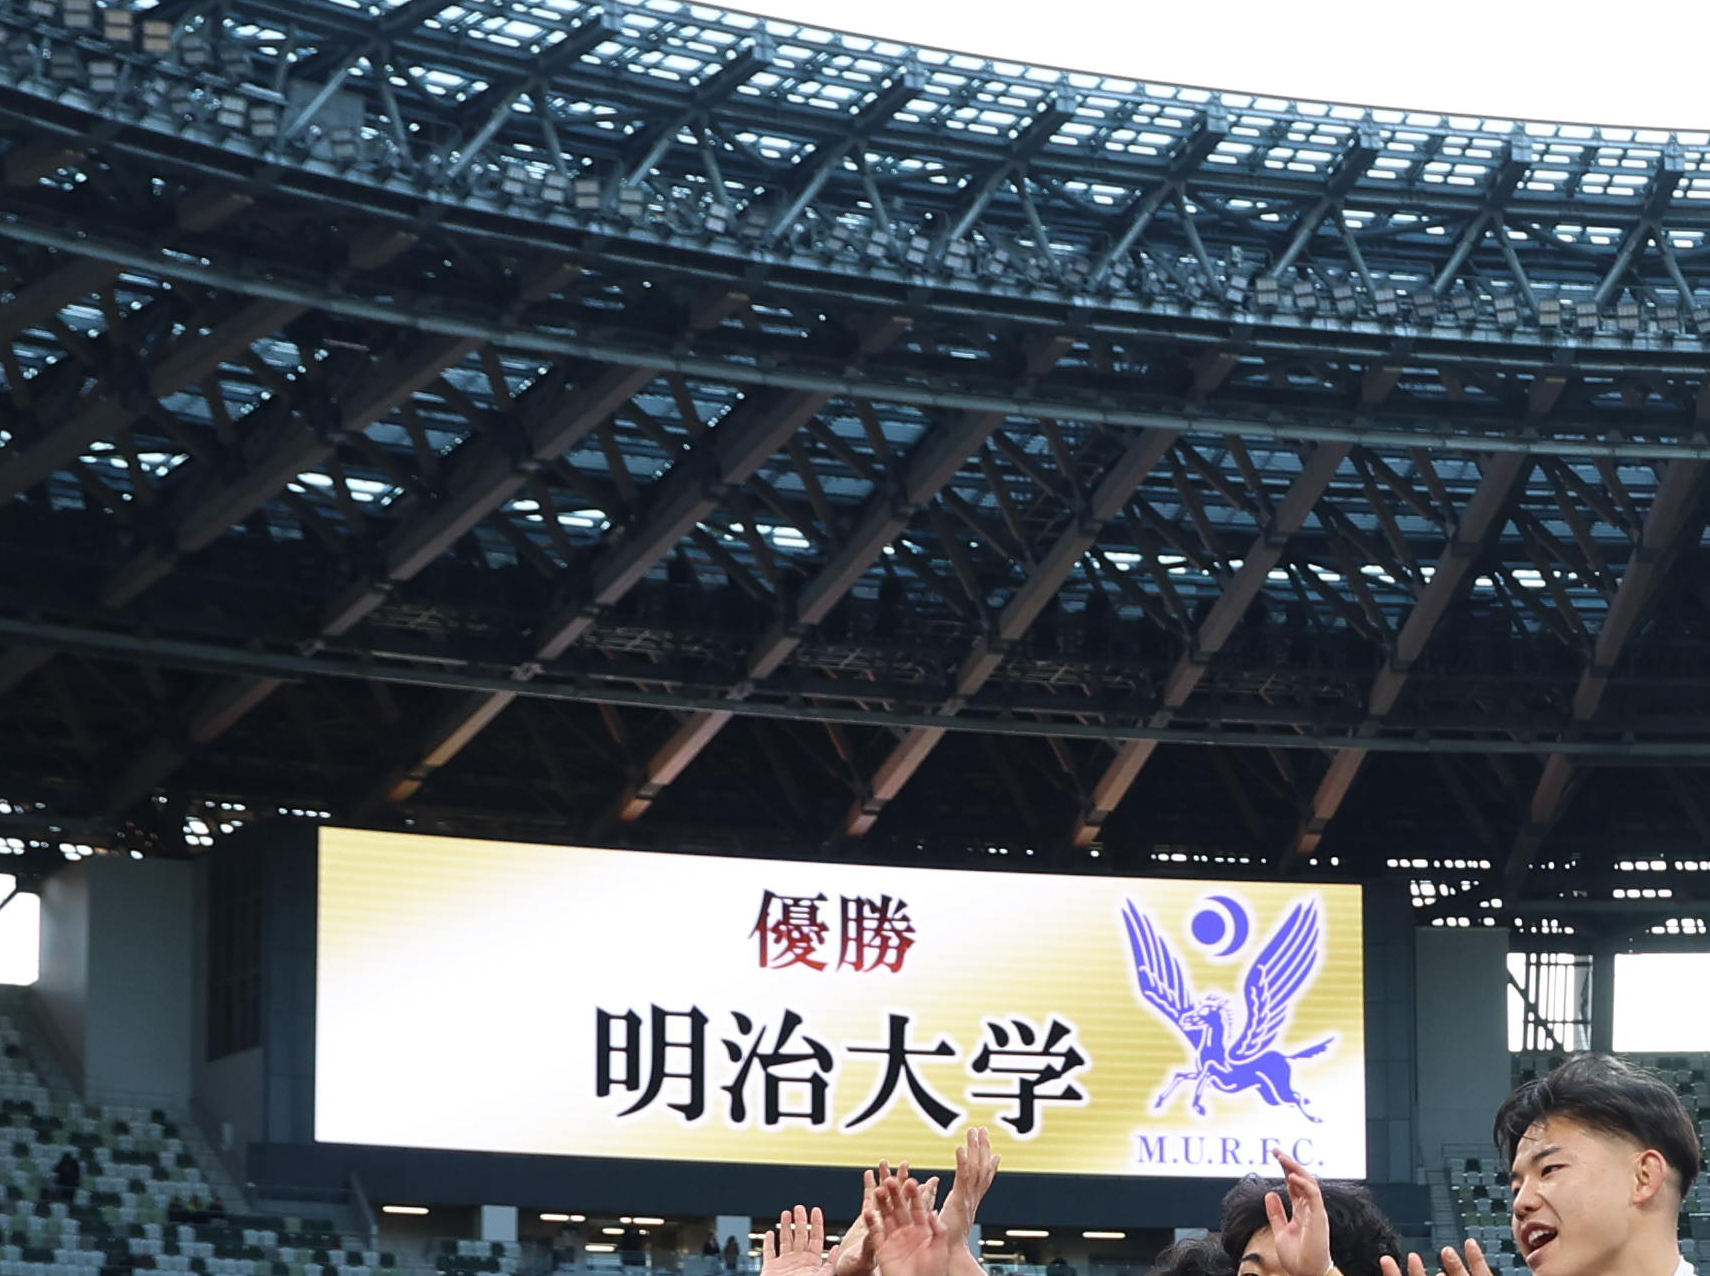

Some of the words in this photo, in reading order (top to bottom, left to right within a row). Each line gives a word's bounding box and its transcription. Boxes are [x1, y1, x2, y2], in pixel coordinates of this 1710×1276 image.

[748, 888, 917, 973] 優勝
[595, 1003, 1087, 1135] 明治大学
[1137, 1134, 1325, 1166] M.U.R.FC.
